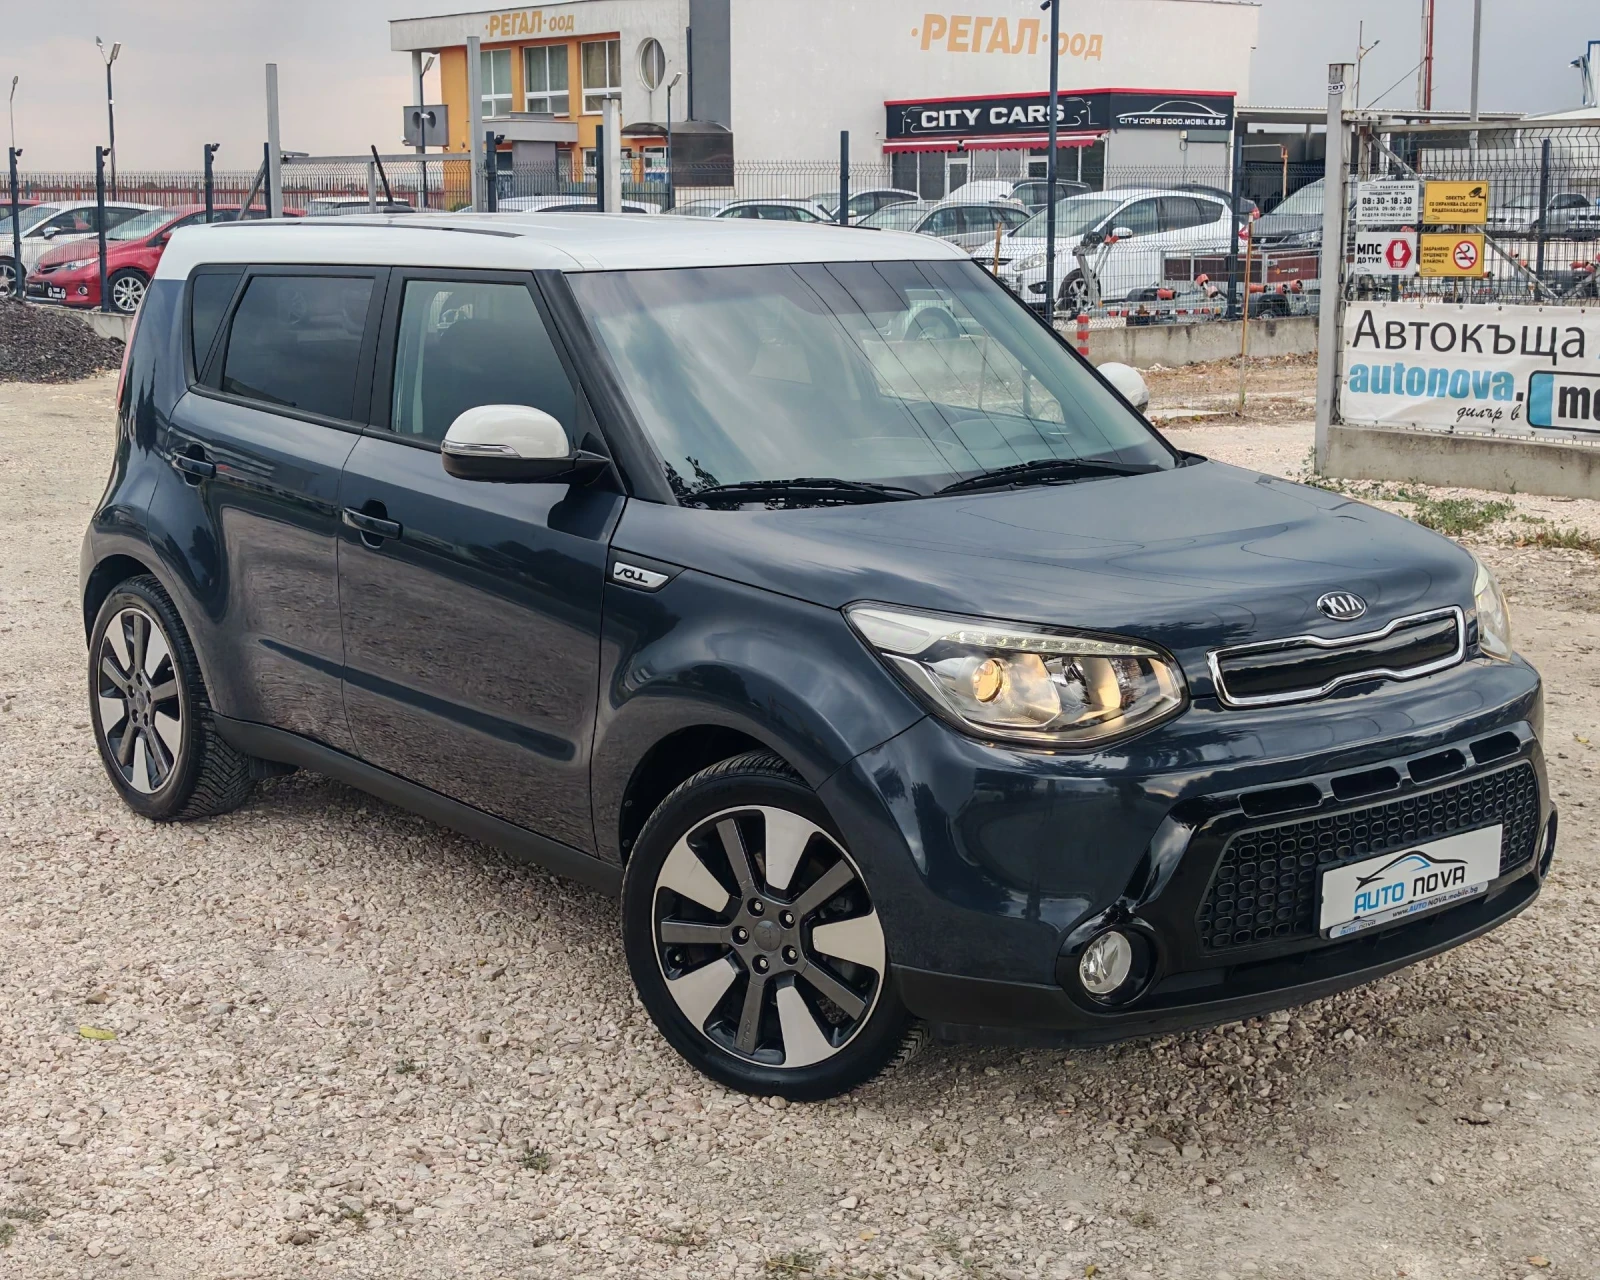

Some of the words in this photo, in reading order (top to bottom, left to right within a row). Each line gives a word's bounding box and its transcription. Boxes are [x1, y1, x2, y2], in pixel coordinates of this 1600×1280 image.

[920, 107, 981, 128] CITY
[989, 103, 1065, 125] CARS
[1139, 117, 1161, 125] CARS
[1357, 243, 1382, 255] МПС
[1357, 256, 1367, 265] ДО
[1367, 256, 1382, 264] ТУК!
[1352, 309, 1585, 366] Автокъща
[1323, 594, 1362, 614] KIA
[1354, 881, 1405, 914] AUTO
[1413, 865, 1466, 897] NOVA
